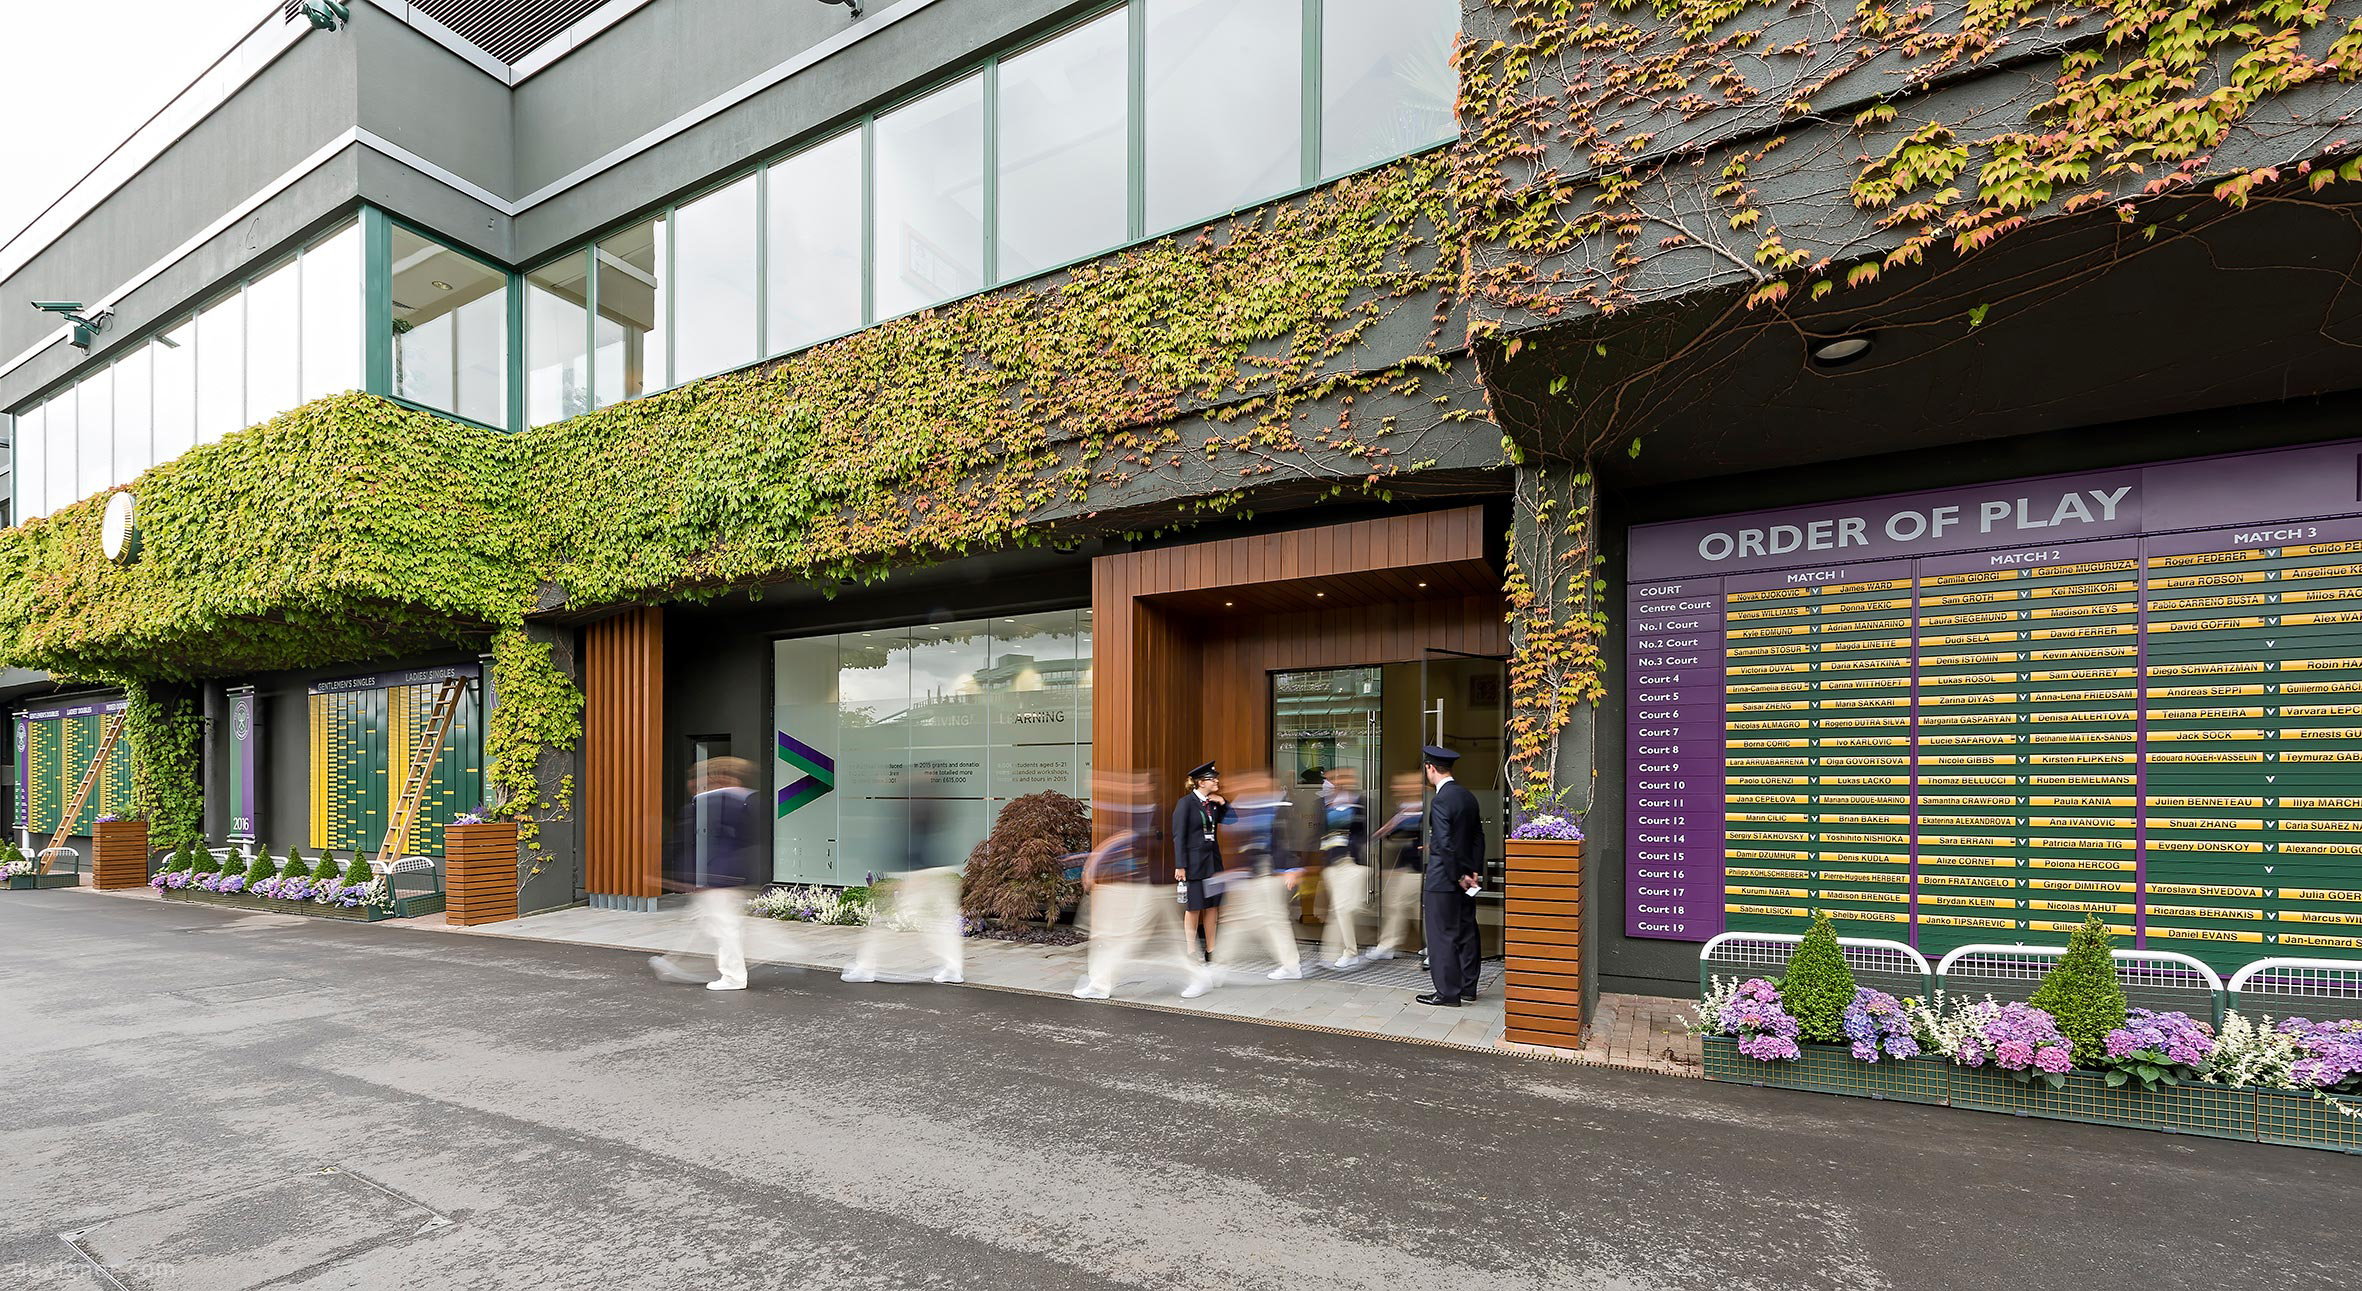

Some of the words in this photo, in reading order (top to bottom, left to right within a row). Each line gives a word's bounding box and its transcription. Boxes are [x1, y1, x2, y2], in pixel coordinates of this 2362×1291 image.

[1698, 517, 1869, 561] ORDER
[1885, 505, 1959, 541] OF
[1980, 486, 2132, 533] PLAY
[2234, 529, 2301, 544] MATCH
[2308, 528, 2317, 537] 3
[1991, 553, 2047, 565] MATCH
[2052, 551, 2060, 559] 2
[2165, 557, 2195, 566] Roger
[2198, 552, 2246, 563] FEDERER
[2076, 561, 2131, 572] MUGURUZA
[1787, 570, 1835, 583] MATCH
[2198, 575, 2243, 585] ROBSON
[1640, 586, 1681, 596] COURT
[1640, 604, 1676, 613] Centre
[1679, 600, 1711, 610] Court
[2051, 608, 2089, 617] Madison
[2091, 606, 2118, 614] KEYS
[1639, 621, 1662, 631] No.1
[1666, 620, 1698, 630] Court
[2171, 623, 2198, 631] David
[2201, 620, 2240, 629] GOFFIN
[1639, 640, 1664, 649] No.2
[1666, 638, 1698, 648] Court
[2043, 651, 2068, 659] Kevin
[2071, 648, 2125, 657] ANDERSON
[1639, 658, 1665, 667] No.3
[1666, 656, 1698, 665] Court
[429, 668, 455, 679] SINGLES
[1741, 666, 1767, 674] Victoria
[1769, 664, 1795, 672] DUVAL
[2153, 668, 2178, 676] Diego
[2181, 664, 2257, 674] SCHWARTZMAN
[318, 680, 352, 691] GENTLEMEN'S
[353, 677, 375, 687] SINGLES
[1639, 675, 1670, 684] Court
[1673, 675, 1679, 683] 4
[2036, 693, 2081, 701] Anna-Lena
[2084, 691, 2132, 700] FRIEDSAM
[2167, 688, 2207, 696] Andreas
[1639, 693, 1670, 702] Court
[1858, 699, 1894, 707] SAKKARI
[1639, 711, 1670, 719] Court
[1672, 710, 1679, 718] 6
[2038, 714, 2069, 722] Denisa
[2071, 713, 2129, 721] ALLERTOVA
[2200, 709, 2246, 717] PEREIRA
[1762, 721, 1800, 729] ALMAGRO
[1639, 728, 1670, 737] Court
[1672, 728, 1679, 736] 7
[2177, 732, 2199, 740] Jack
[2202, 731, 2232, 739] SOCK
[1639, 746, 1670, 754] Court
[1639, 764, 1670, 772] Court
[1672, 763, 1679, 771] 9
[1639, 781, 1670, 789] Court
[1674, 781, 1685, 789] 10
[1639, 799, 1670, 807] Court
[1674, 799, 1684, 807] 11
[2188, 798, 2252, 806] BENNETEAU
[233, 817, 249, 830] 2016
[1639, 817, 1670, 825] Court
[1673, 817, 1684, 825] 12
[2170, 820, 2196, 828] Shuai
[1639, 834, 1669, 842] Court
[1673, 834, 1684, 843] 14
[2159, 842, 2194, 851] Evgeny
[2198, 843, 2249, 851] DONSKOY
[1638, 852, 1669, 860] Court
[1673, 852, 1684, 861] 15
[2078, 861, 2120, 869] HERCOG
[1638, 870, 1669, 878] Court
[1673, 870, 1684, 879] 16
[2044, 881, 2071, 890] Grigor
[2074, 882, 2121, 891] DIMITROV
[1638, 887, 1669, 896] Court
[1673, 888, 1684, 896] 17
[2200, 887, 2256, 896] SHVEDOVA
[1861, 893, 1900, 901] BRENGLE
[1937, 897, 1966, 906] Brydan
[1638, 905, 1669, 914] Court
[1673, 905, 1684, 914] 18
[2048, 902, 2080, 911] Nicolas
[2083, 903, 2117, 912] MAHUT
[1833, 911, 1858, 919] Shelby
[1861, 912, 1895, 921] ROGERS
[2154, 907, 2196, 916] Ricardas
[2200, 909, 2254, 918] BERANKIS
[1638, 923, 1669, 931] Court
[1673, 923, 1684, 932] 19
[2169, 930, 2199, 938] Daniel
[2202, 932, 2237, 940] EVANS
